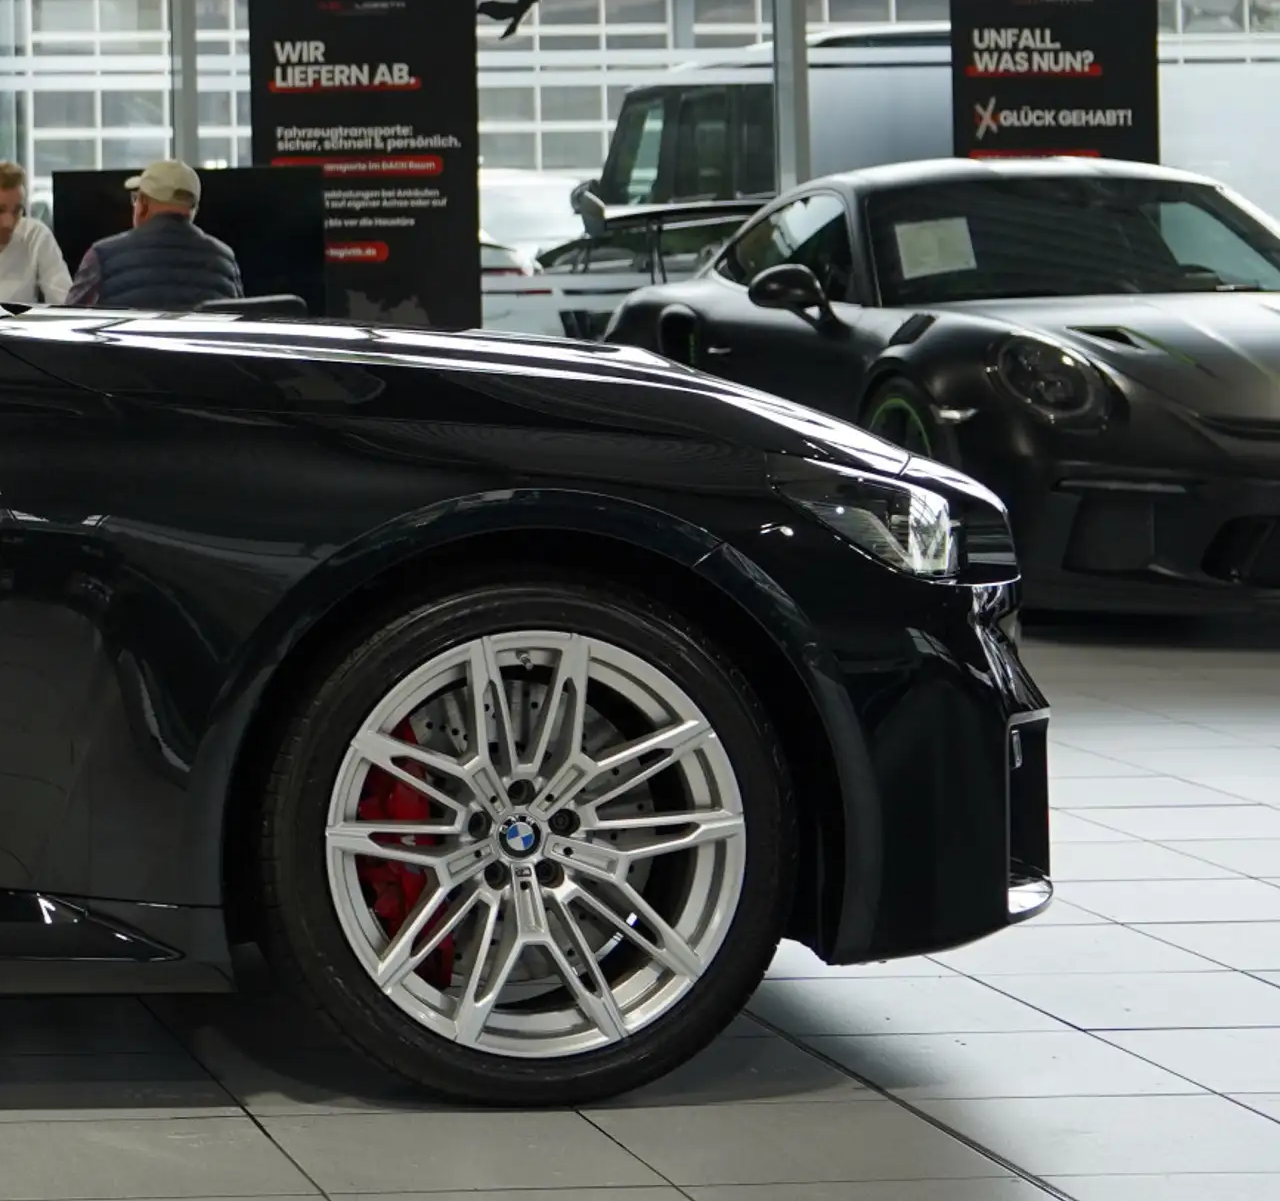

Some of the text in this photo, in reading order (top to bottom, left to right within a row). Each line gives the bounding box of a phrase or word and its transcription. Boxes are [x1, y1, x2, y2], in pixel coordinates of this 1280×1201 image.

[973, 27, 1062, 50] UNFALL.
[274, 40, 326, 65] WIR
[973, 49, 1095, 73] WAS NUN?
[275, 61, 417, 89] LIEFERN AB.
[999, 106, 1133, 128] GLÜCK GEHABT!
[276, 134, 462, 153] sicher, schnell & persönlich.
